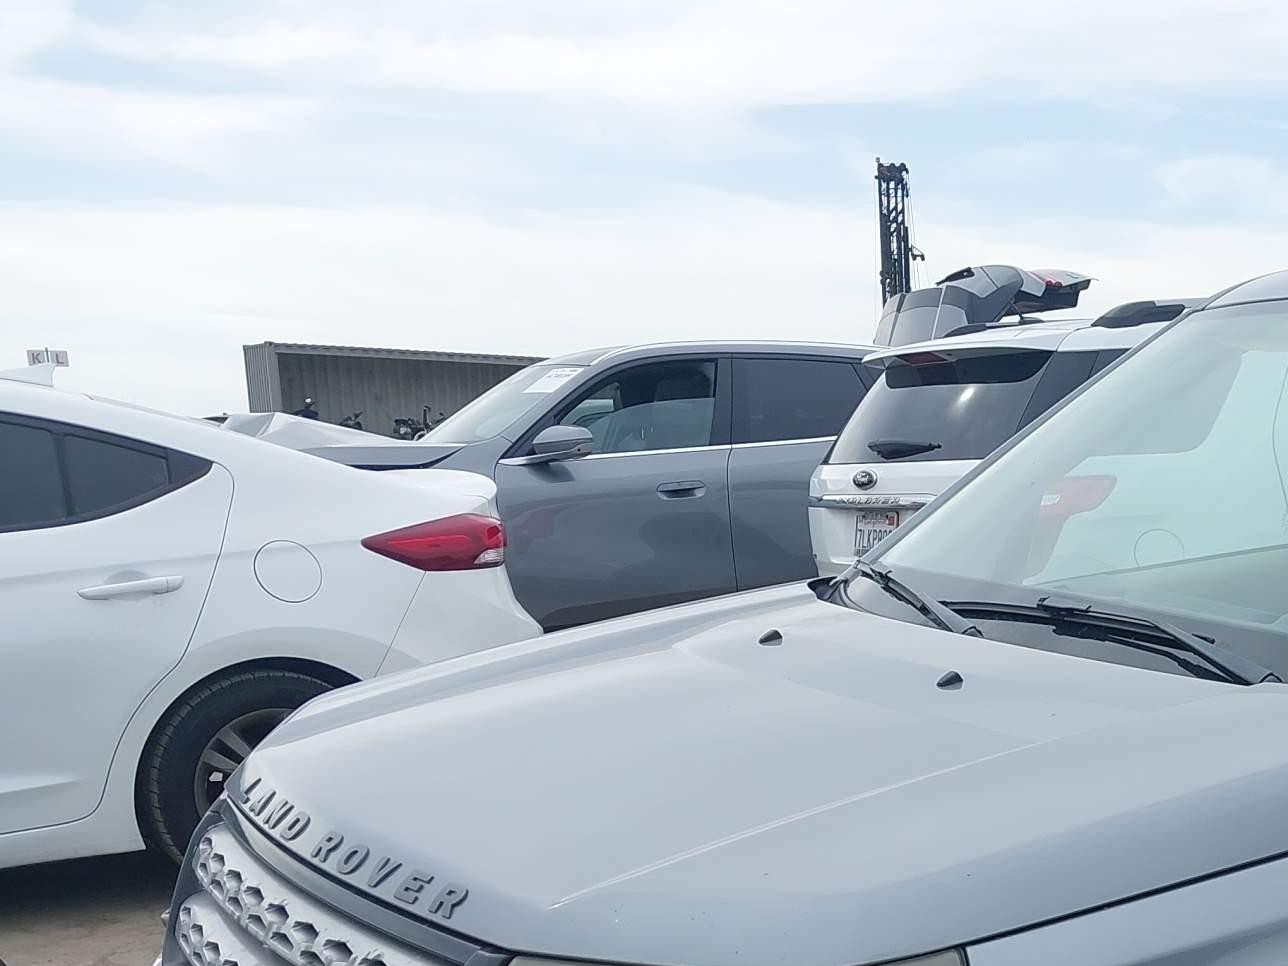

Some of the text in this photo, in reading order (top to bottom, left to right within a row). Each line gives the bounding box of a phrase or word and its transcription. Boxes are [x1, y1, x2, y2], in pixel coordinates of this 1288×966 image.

[31, 352, 42, 365] K
[55, 352, 65, 365] L
[241, 777, 470, 920] LAND ROVER
